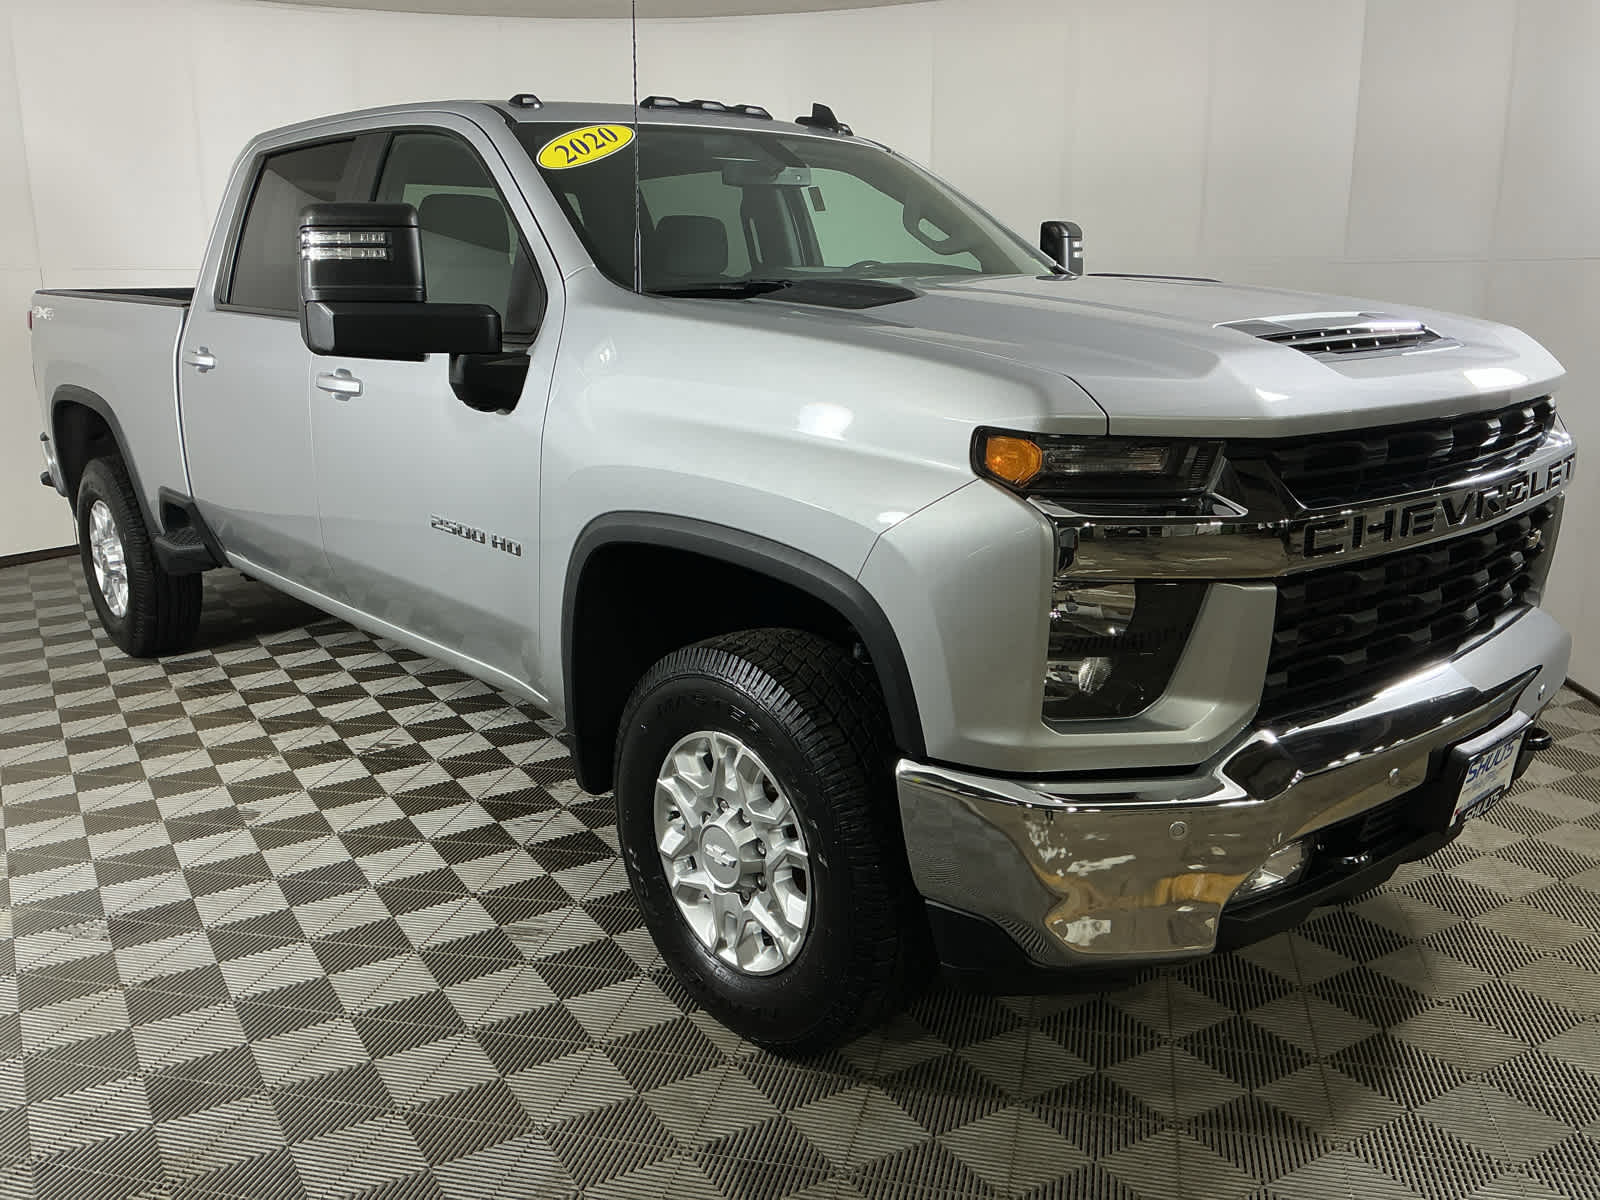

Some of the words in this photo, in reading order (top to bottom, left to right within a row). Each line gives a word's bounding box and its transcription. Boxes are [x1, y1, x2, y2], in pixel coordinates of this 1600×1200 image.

[554, 127, 618, 164] 2020
[1303, 452, 1576, 558] CHEVROLET
[430, 513, 486, 544] 2500
[492, 535, 522, 557] HD
